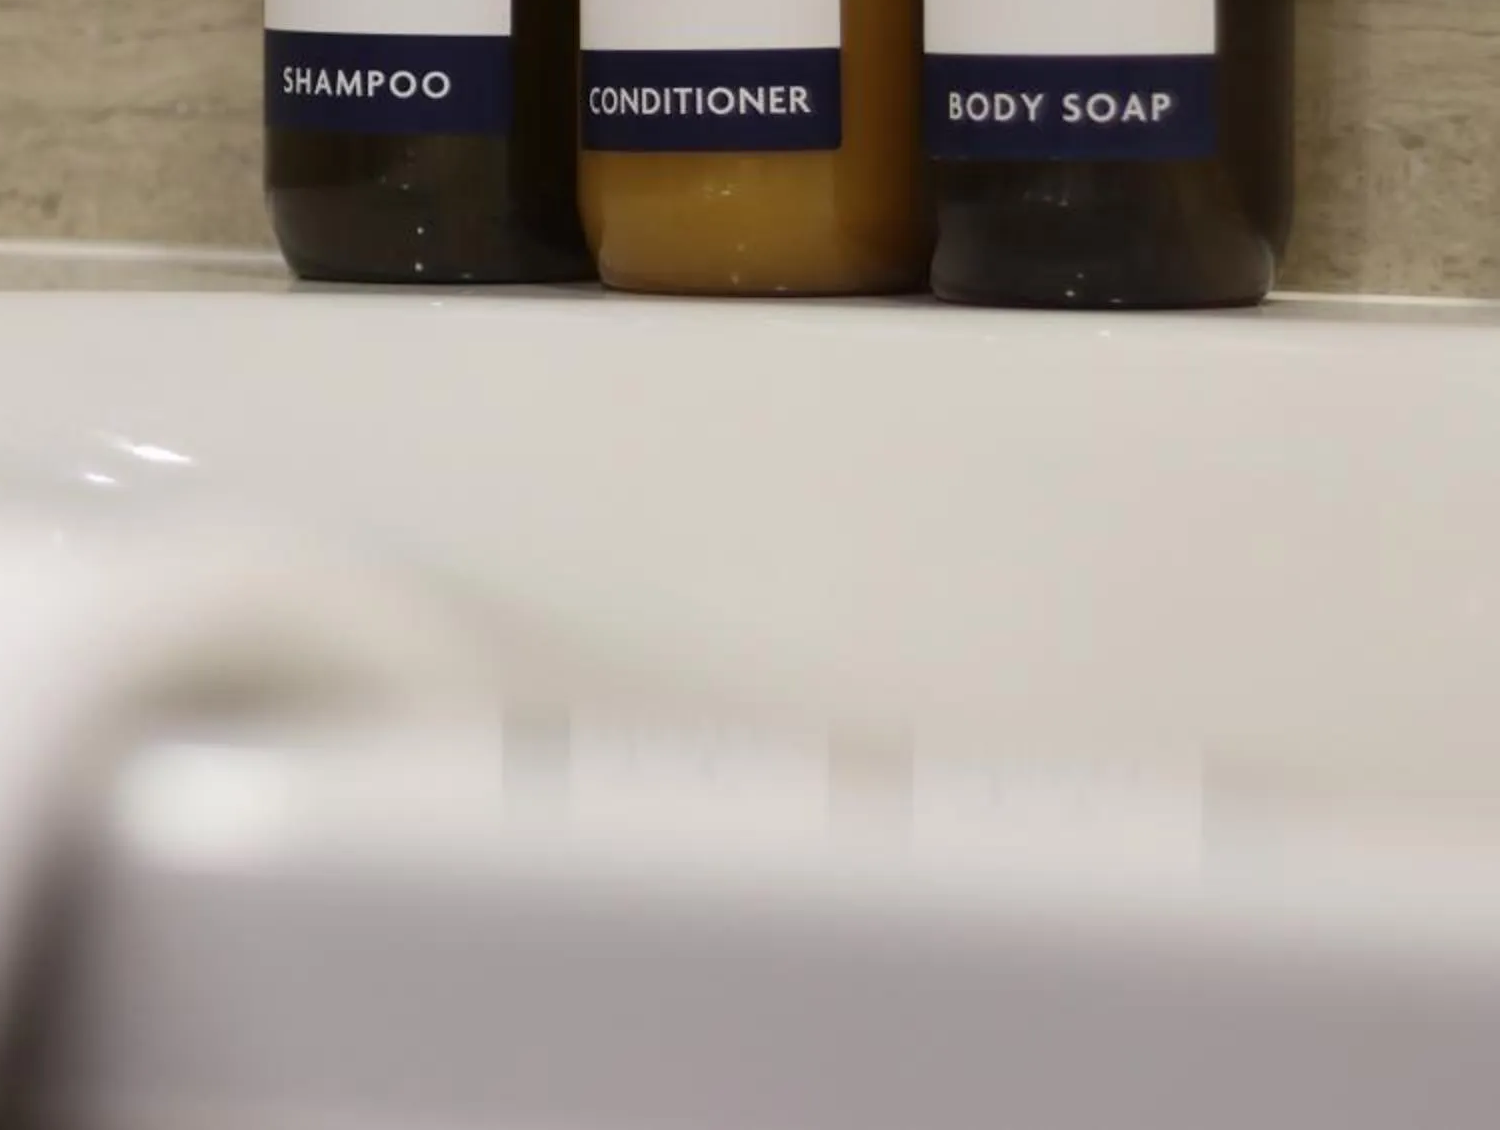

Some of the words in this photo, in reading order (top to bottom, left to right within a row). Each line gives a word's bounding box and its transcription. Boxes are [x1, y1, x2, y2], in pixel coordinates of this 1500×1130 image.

[283, 67, 451, 98] SHAMPOO
[589, 85, 811, 115] CONDITIONER
[949, 91, 1043, 122] BODY
[1062, 92, 1173, 123] SOAP
